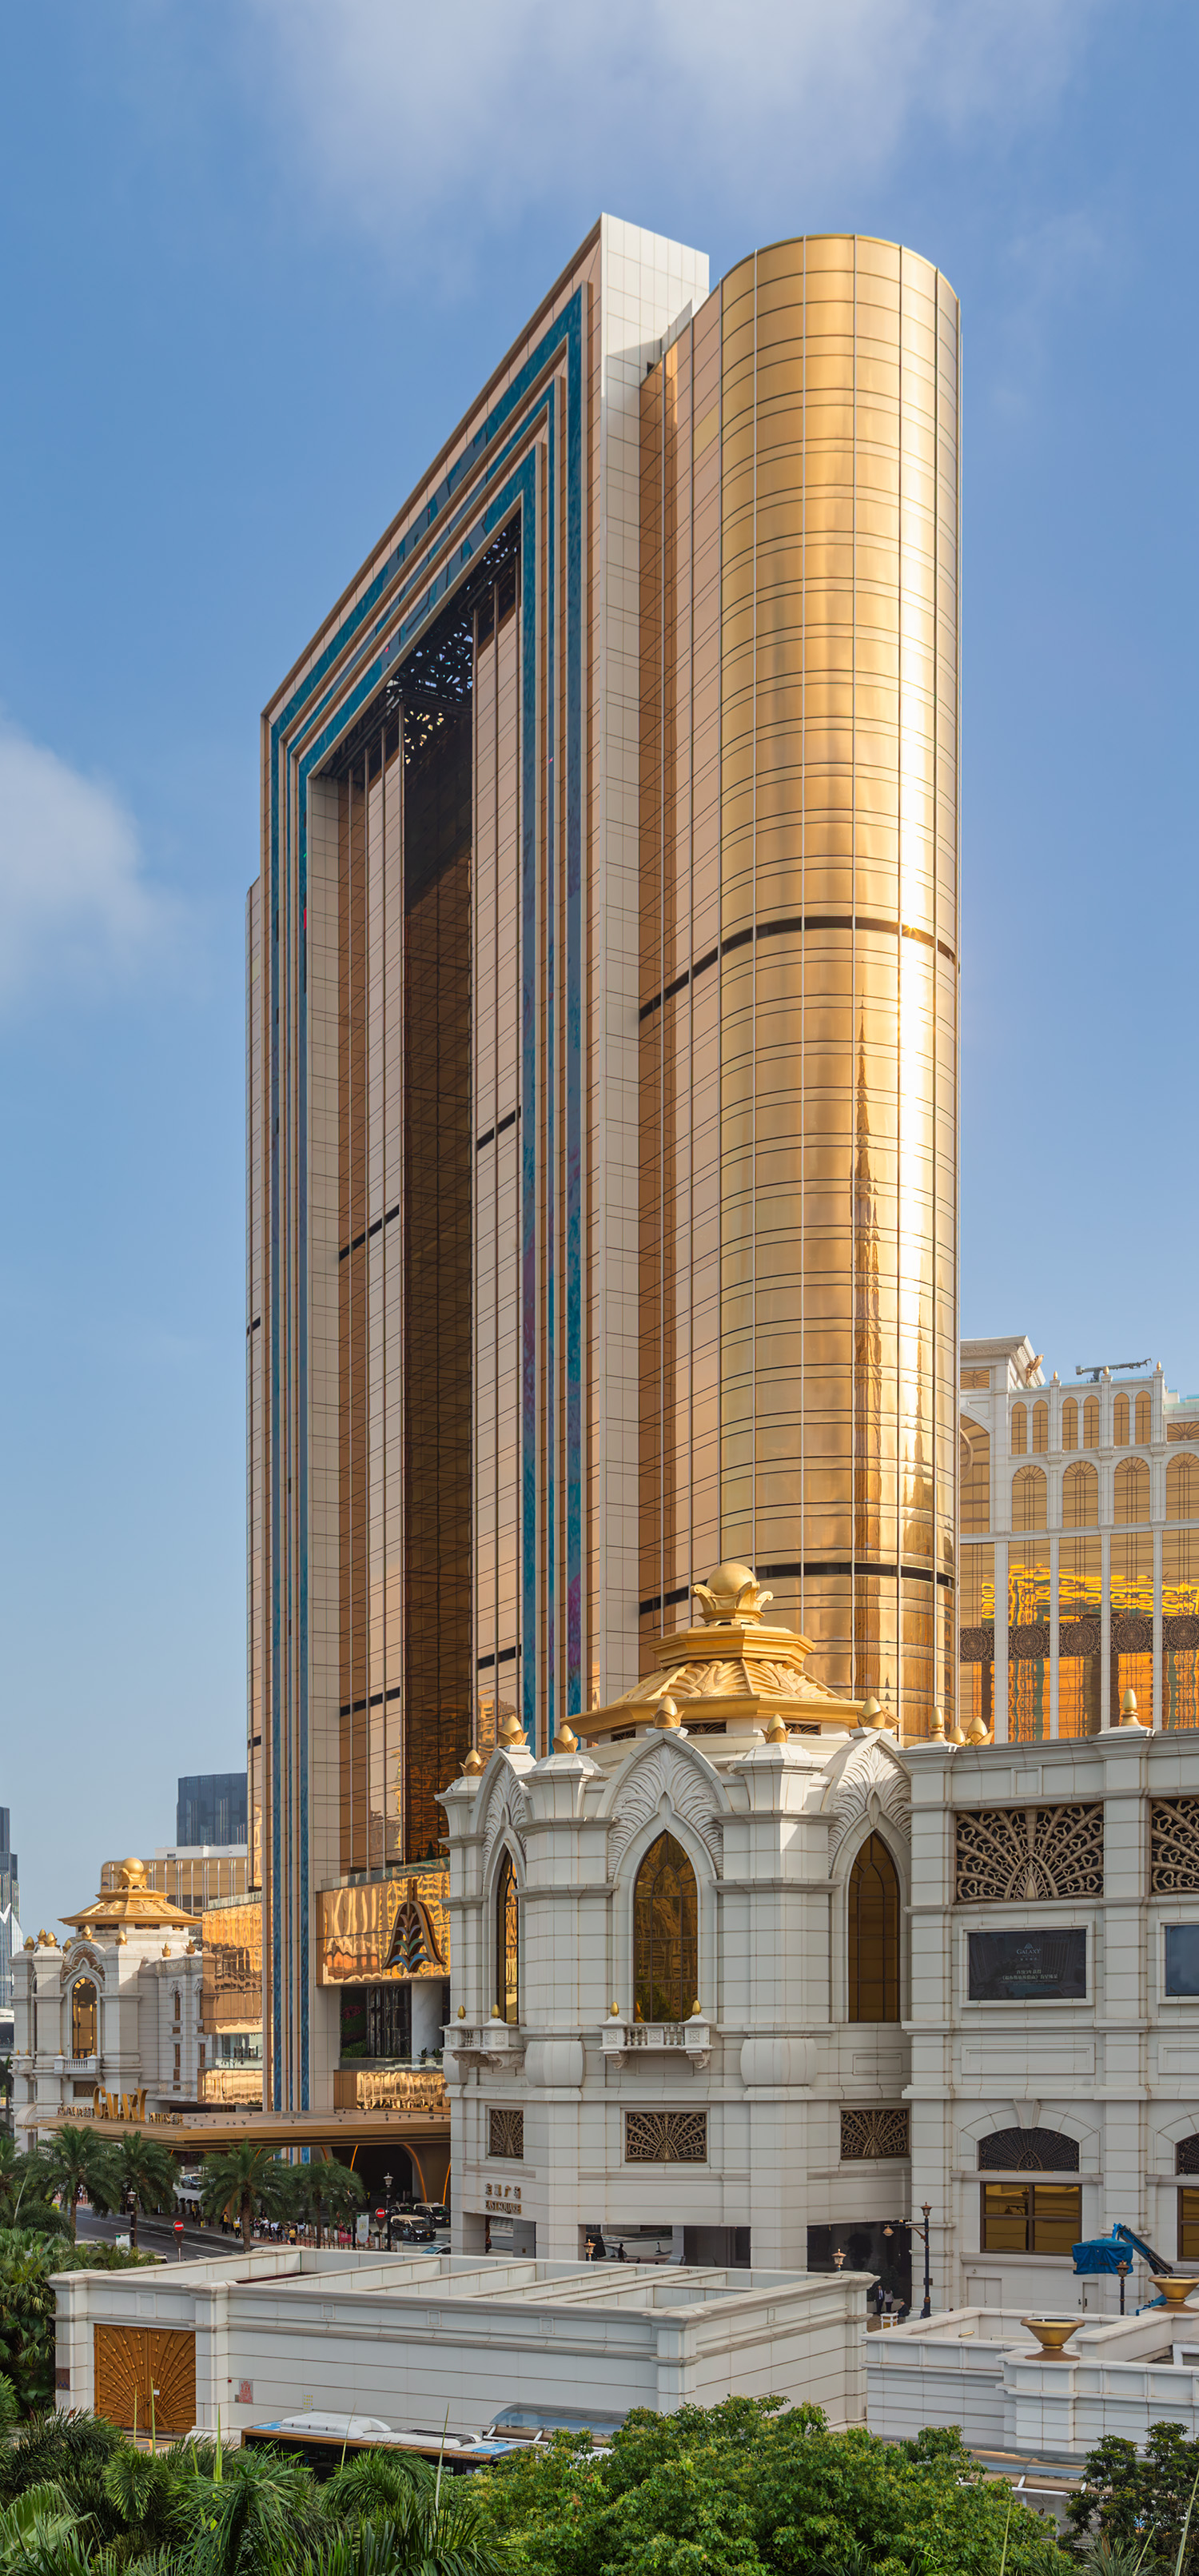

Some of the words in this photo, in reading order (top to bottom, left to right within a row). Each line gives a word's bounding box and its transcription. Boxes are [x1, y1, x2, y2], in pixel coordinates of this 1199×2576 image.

[93, 2085, 149, 2122] GALAXY
[484, 2200, 499, 2211] EAST
[499, 2202, 522, 2214] SQUARE
